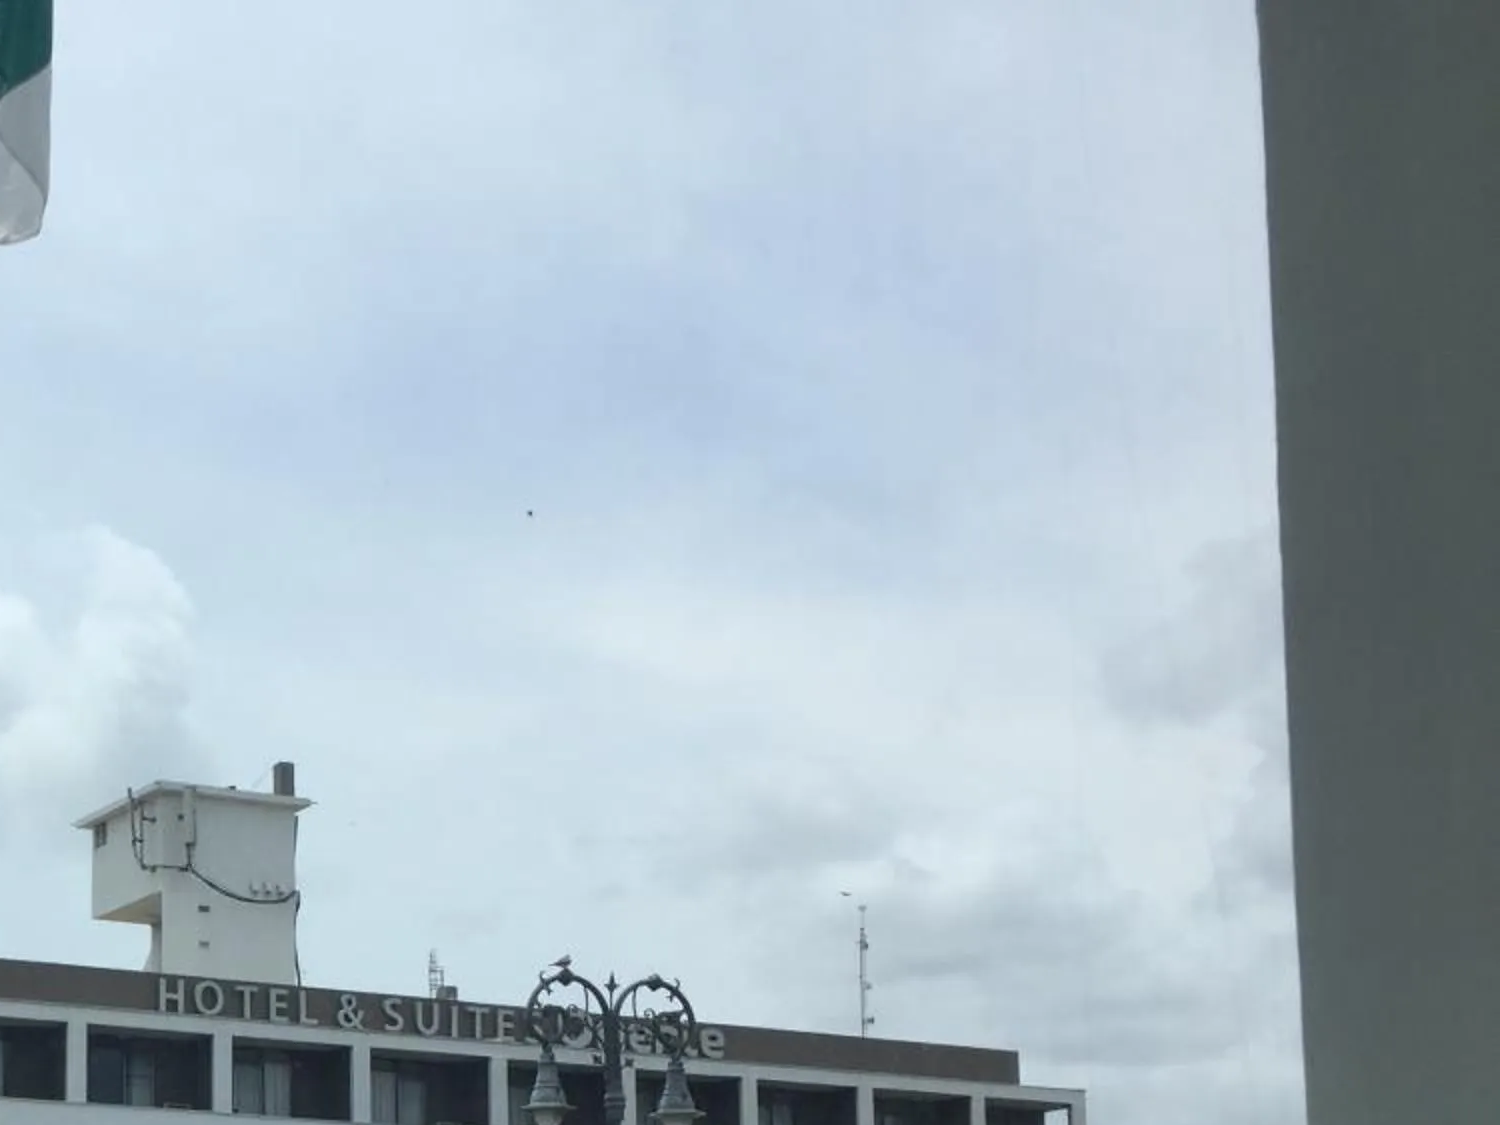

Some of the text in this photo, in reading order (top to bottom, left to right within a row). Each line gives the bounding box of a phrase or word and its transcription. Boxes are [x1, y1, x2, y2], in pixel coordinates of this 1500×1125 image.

[159, 977, 319, 1025] HOTEL
[336, 993, 364, 1031] &
[557, 1006, 726, 1060] Oente
